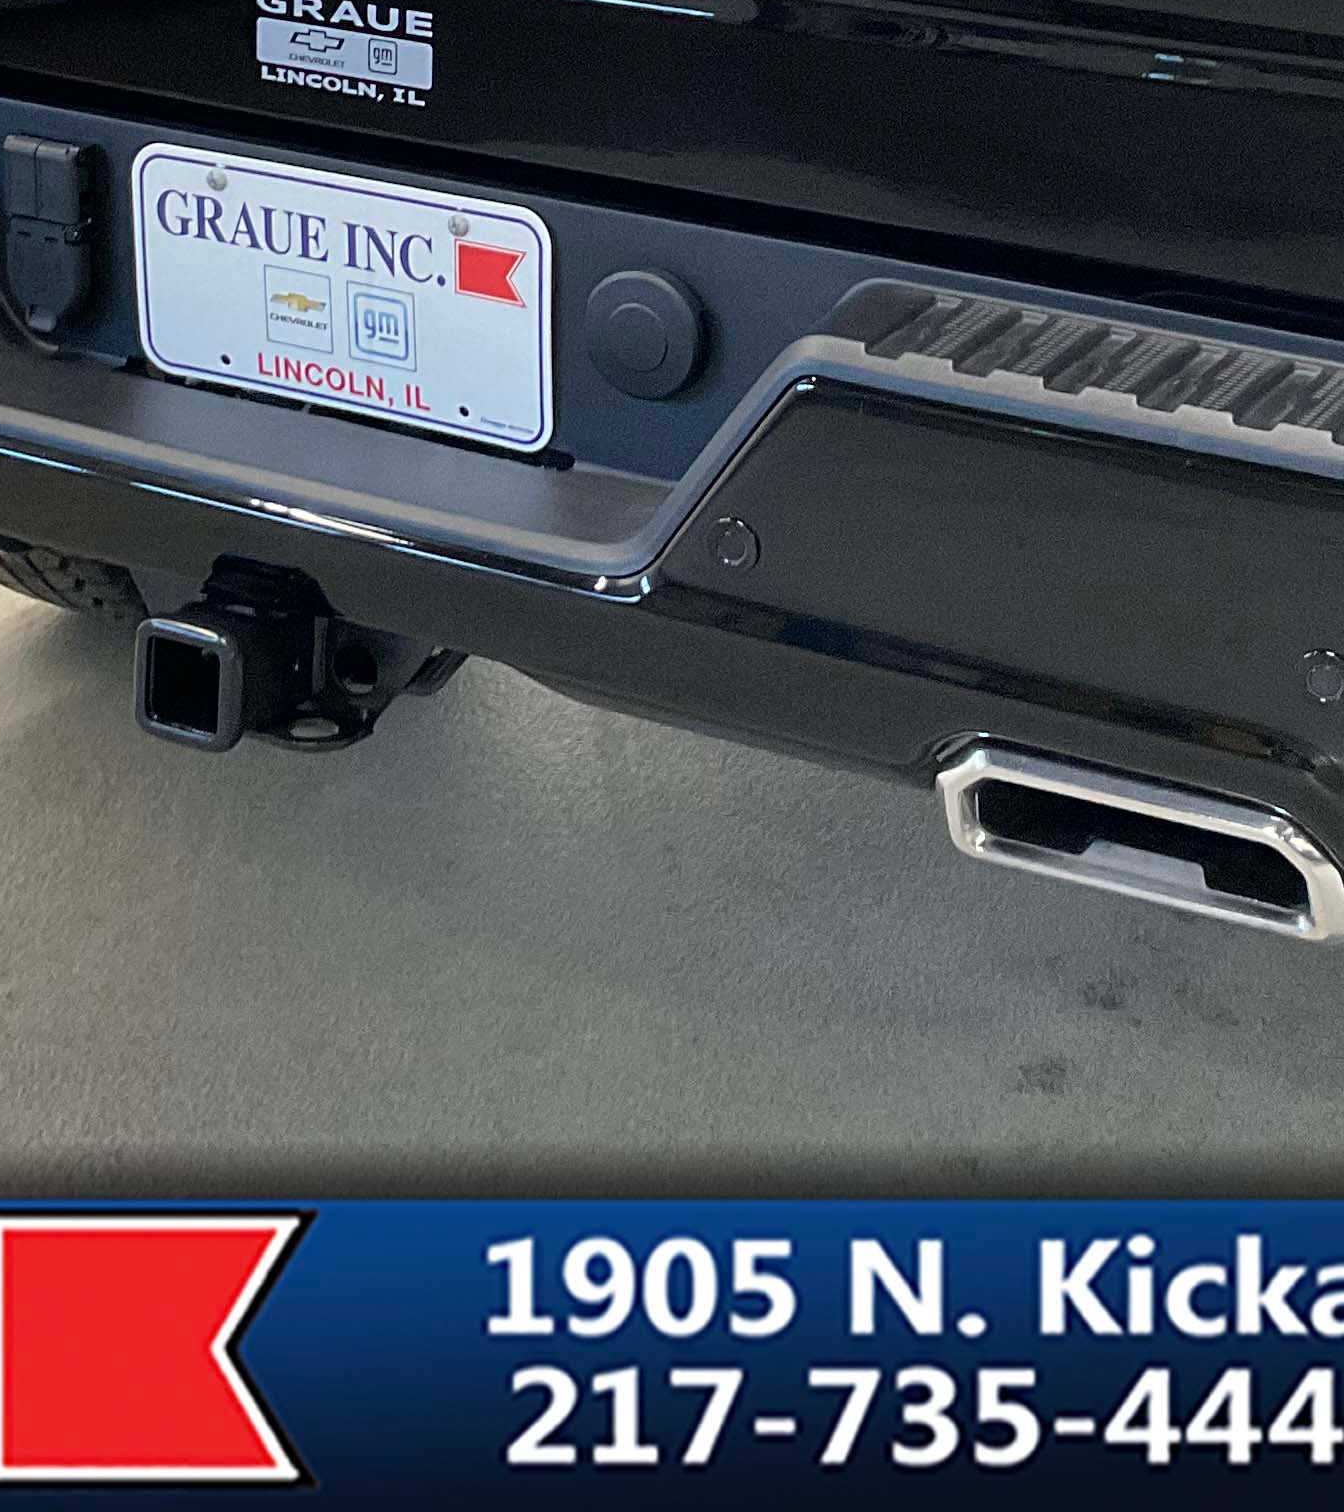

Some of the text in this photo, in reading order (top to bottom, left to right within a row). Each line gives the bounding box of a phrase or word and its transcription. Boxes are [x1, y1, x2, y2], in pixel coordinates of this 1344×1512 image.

[288, 52, 345, 69] CHEVROLET
[373, 47, 393, 66] gm
[260, 65, 426, 107] LINCOLN, IL
[156, 188, 447, 288] GRAUE INC.
[269, 311, 329, 331] CHEVROLET
[363, 308, 400, 345] gm
[257, 351, 432, 412] LINCOLN, IL
